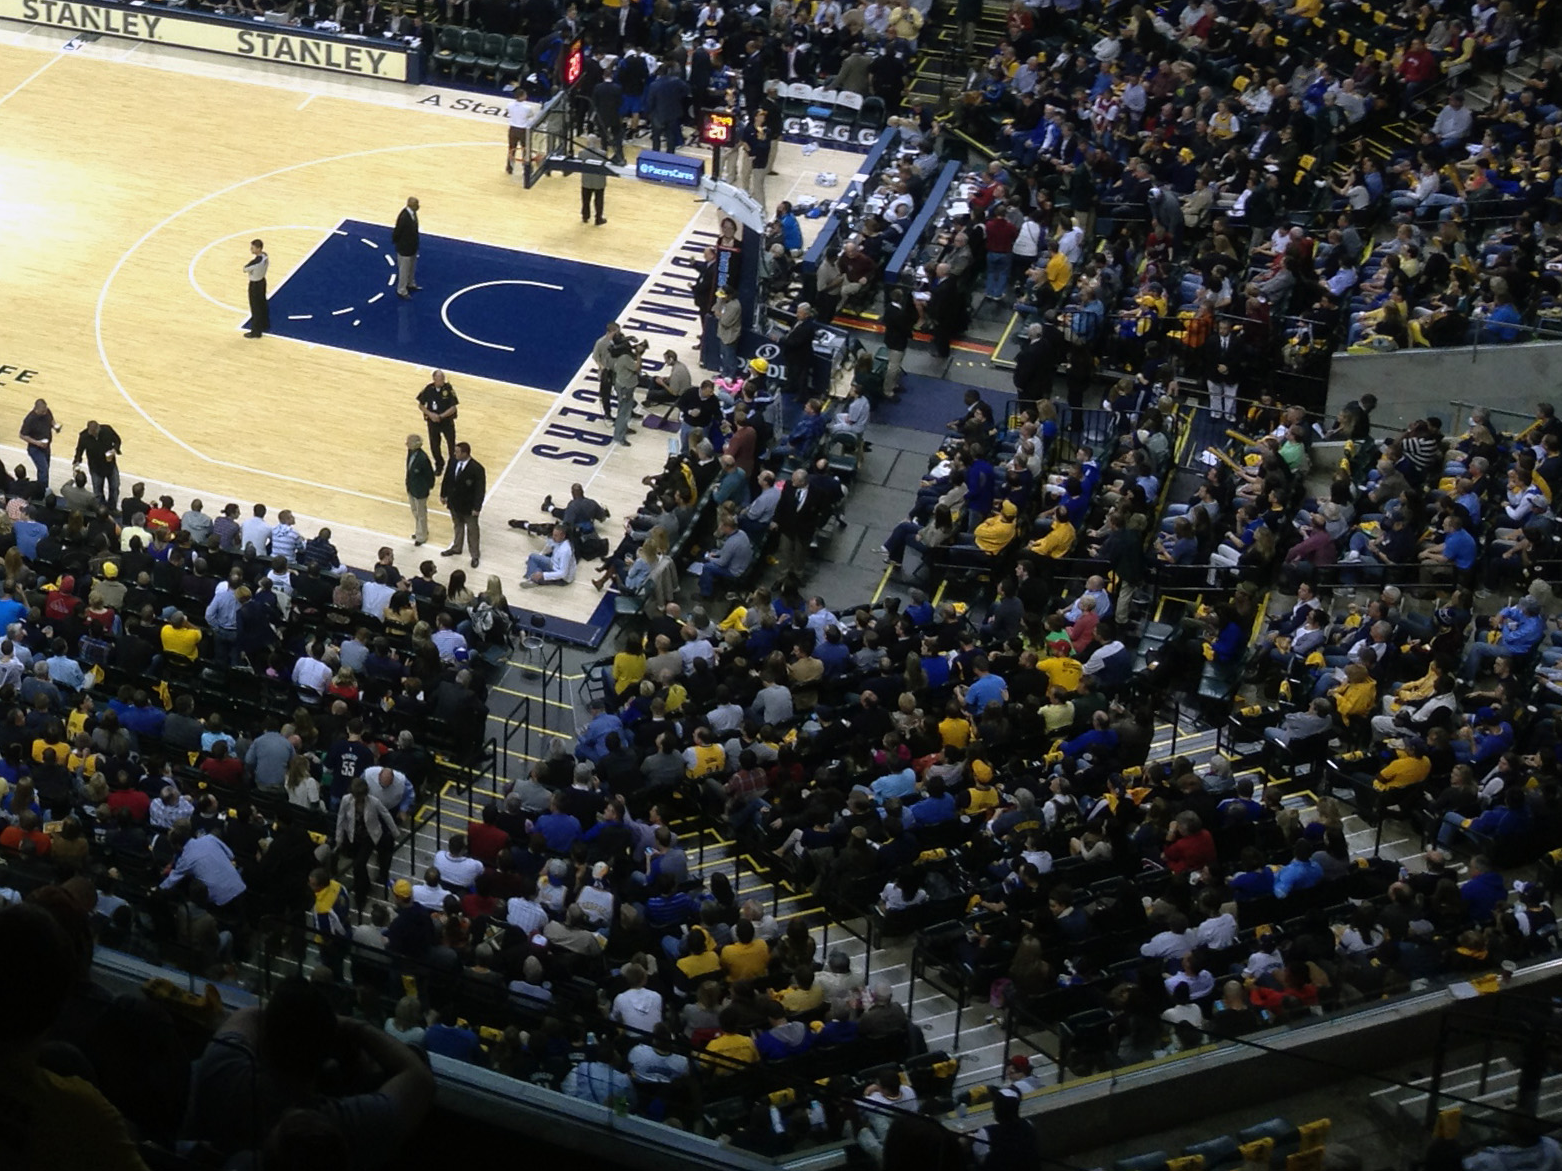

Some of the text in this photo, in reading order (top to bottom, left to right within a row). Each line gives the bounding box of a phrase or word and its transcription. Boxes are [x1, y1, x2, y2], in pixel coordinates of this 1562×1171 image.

[237, 30, 388, 76] STANLEY
[416, 94, 441, 107] A
[709, 126, 726, 139] 20
[640, 163, 694, 180] @PacersCares
[341, 761, 355, 777] 55
